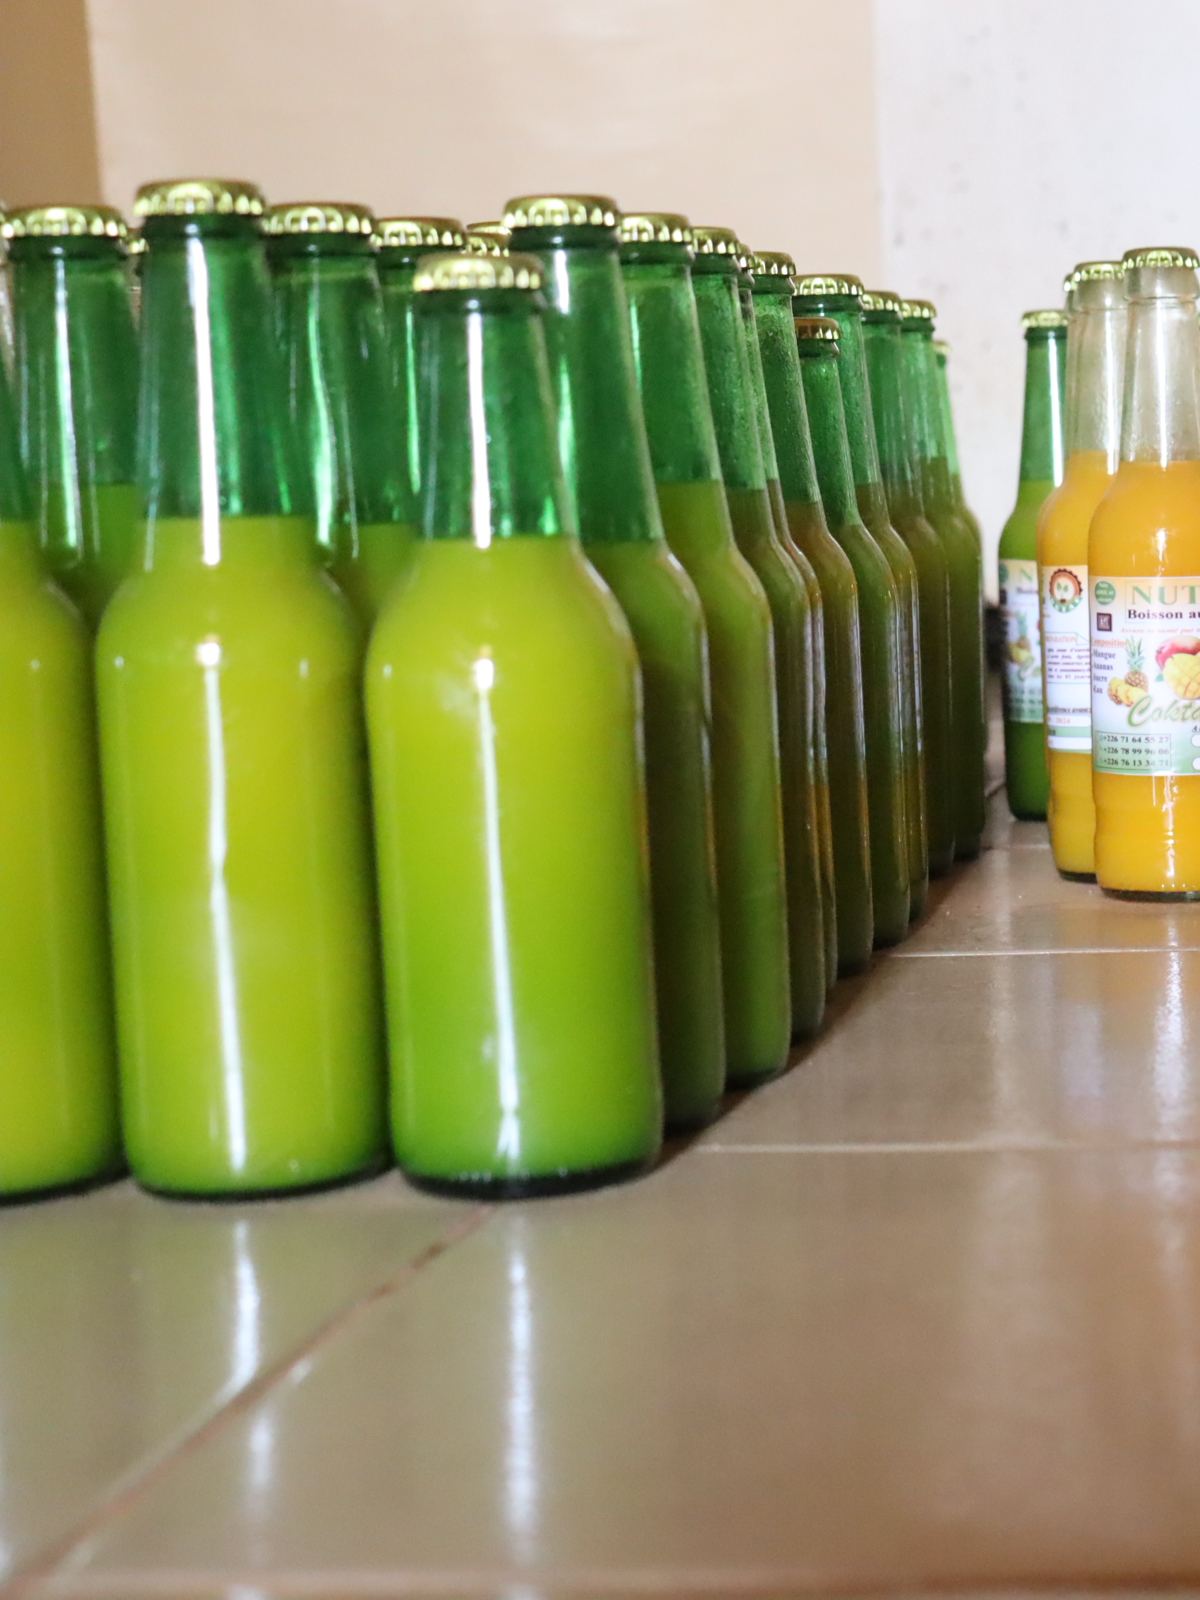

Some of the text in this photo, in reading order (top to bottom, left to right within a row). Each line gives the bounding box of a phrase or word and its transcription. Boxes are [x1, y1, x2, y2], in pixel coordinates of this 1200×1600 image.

[1128, 609, 1183, 620] Boisson
[1180, 627, 1194, 635] par
[1091, 637, 1128, 648] Cmpositio
[1093, 648, 1116, 660] Mangue
[1093, 662, 1114, 670] Ananas
[1093, 674, 1108, 682] Sucre
[1103, 734, 1118, 743] +226
[1121, 734, 1129, 743] 71
[1132, 734, 1142, 743] 64
[1144, 734, 1156, 743] 55
[1104, 746, 1169, 755] +226 78 99 96 06
[1104, 757, 1169, 766] +226 76 13 34 71
